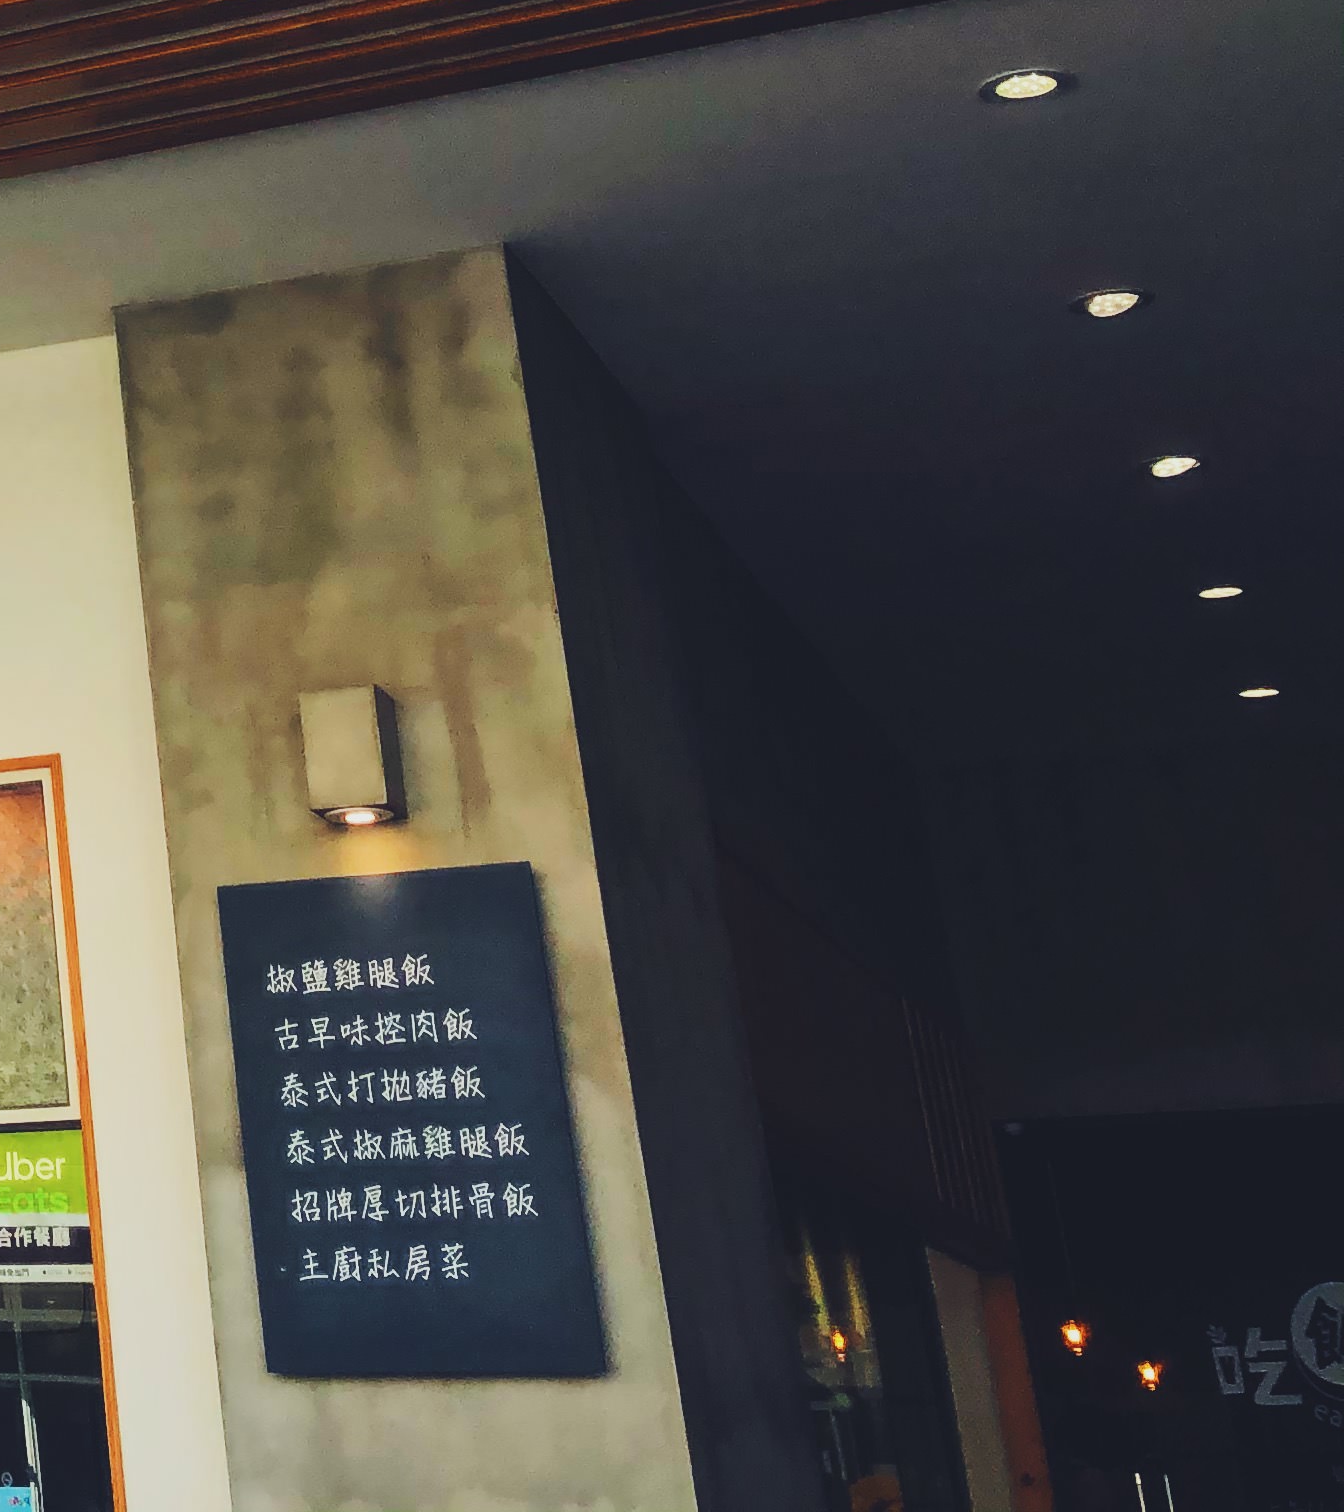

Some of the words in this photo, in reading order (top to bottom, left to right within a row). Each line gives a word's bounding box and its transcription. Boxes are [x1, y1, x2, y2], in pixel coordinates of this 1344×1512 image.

[266, 953, 435, 995] 椒鹽雞腿飯
[273, 1007, 478, 1051] 古早味控肉飯
[286, 1122, 530, 1165] 泰式椒麻雞腿飯
[290, 1182, 539, 1223] 招牌厚切排骨飯
[298, 1242, 471, 1283] 主廚私房菜
